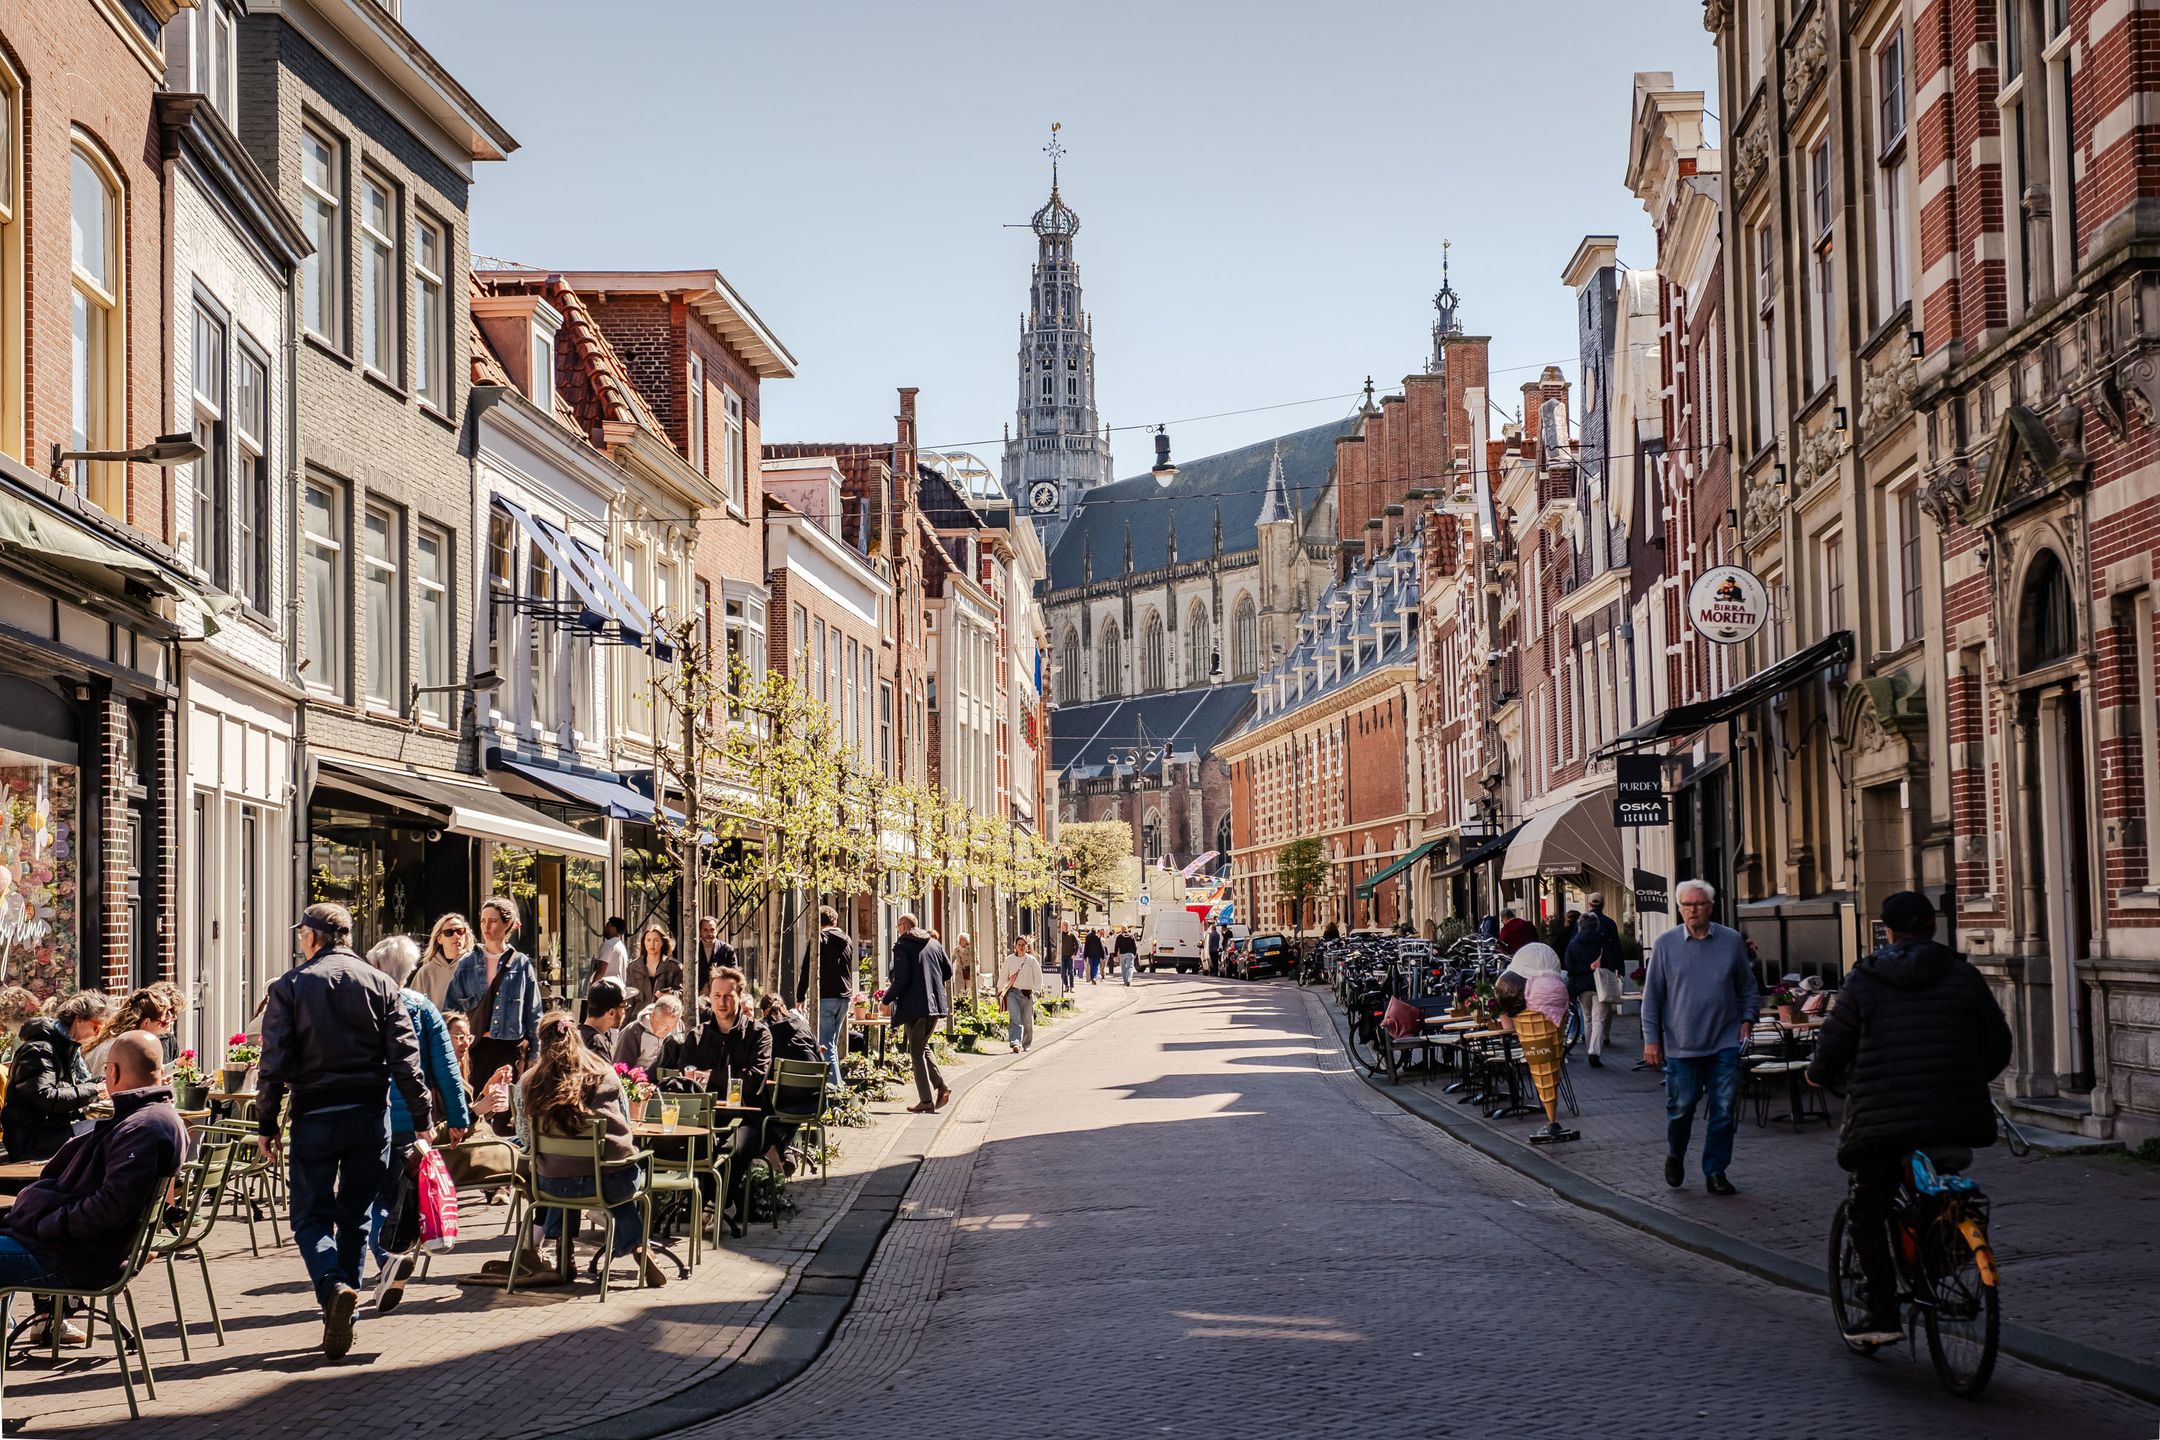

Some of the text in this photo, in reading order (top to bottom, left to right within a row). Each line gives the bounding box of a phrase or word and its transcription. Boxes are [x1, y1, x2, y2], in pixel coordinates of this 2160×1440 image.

[1714, 603, 1746, 612] BIRRA
[1700, 609, 1756, 625] MORETTI
[1620, 781, 1660, 791] PURDEY
[1619, 802, 1662, 811] OSKA
[1635, 889, 1668, 897] OSKA
